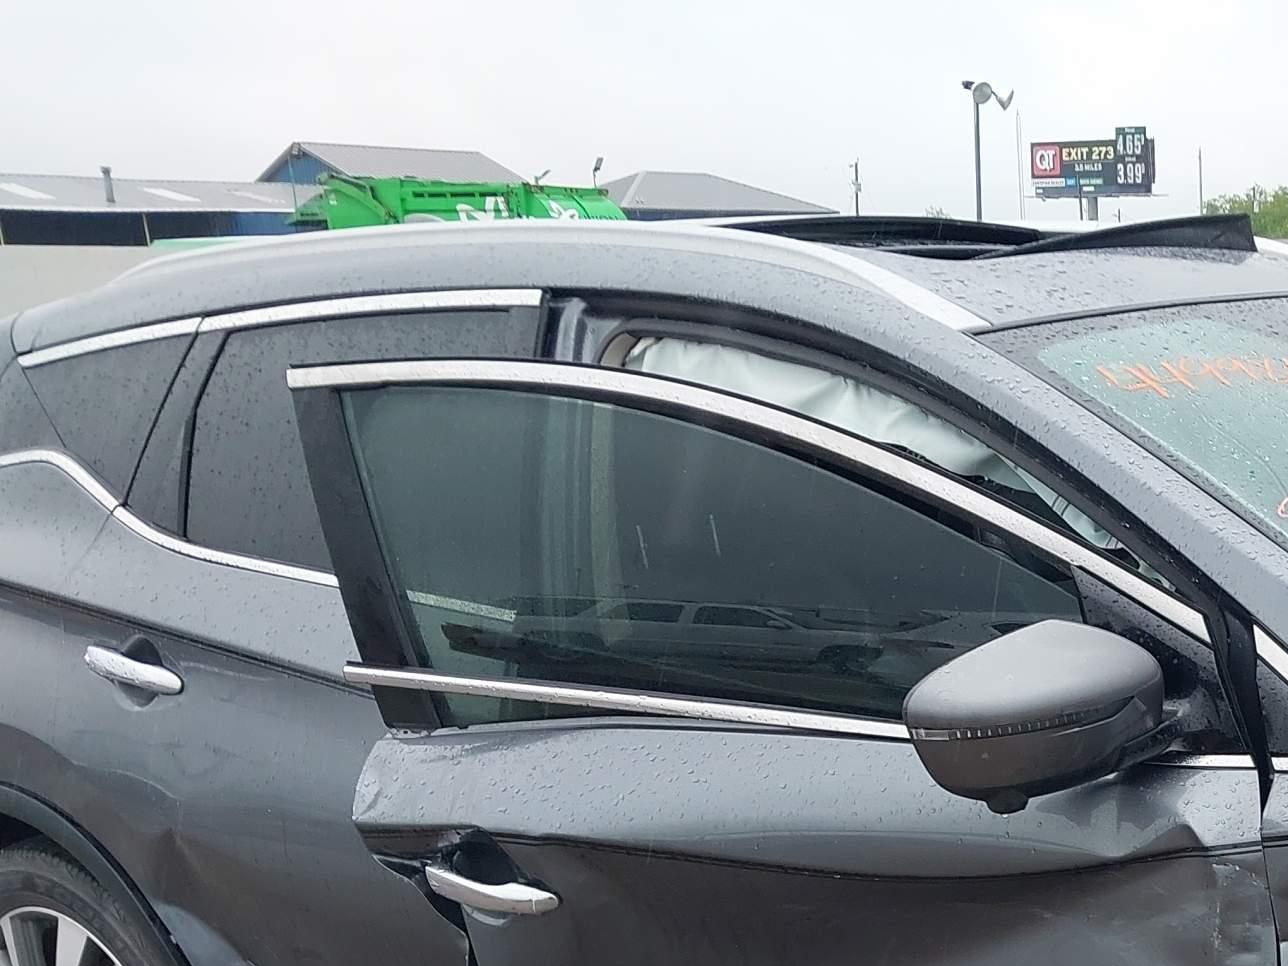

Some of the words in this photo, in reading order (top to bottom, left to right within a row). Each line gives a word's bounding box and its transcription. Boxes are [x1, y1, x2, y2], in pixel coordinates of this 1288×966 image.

[1035, 149, 1056, 172] QT
[1062, 146, 1089, 161] EXIT
[1091, 145, 1115, 160] 273
